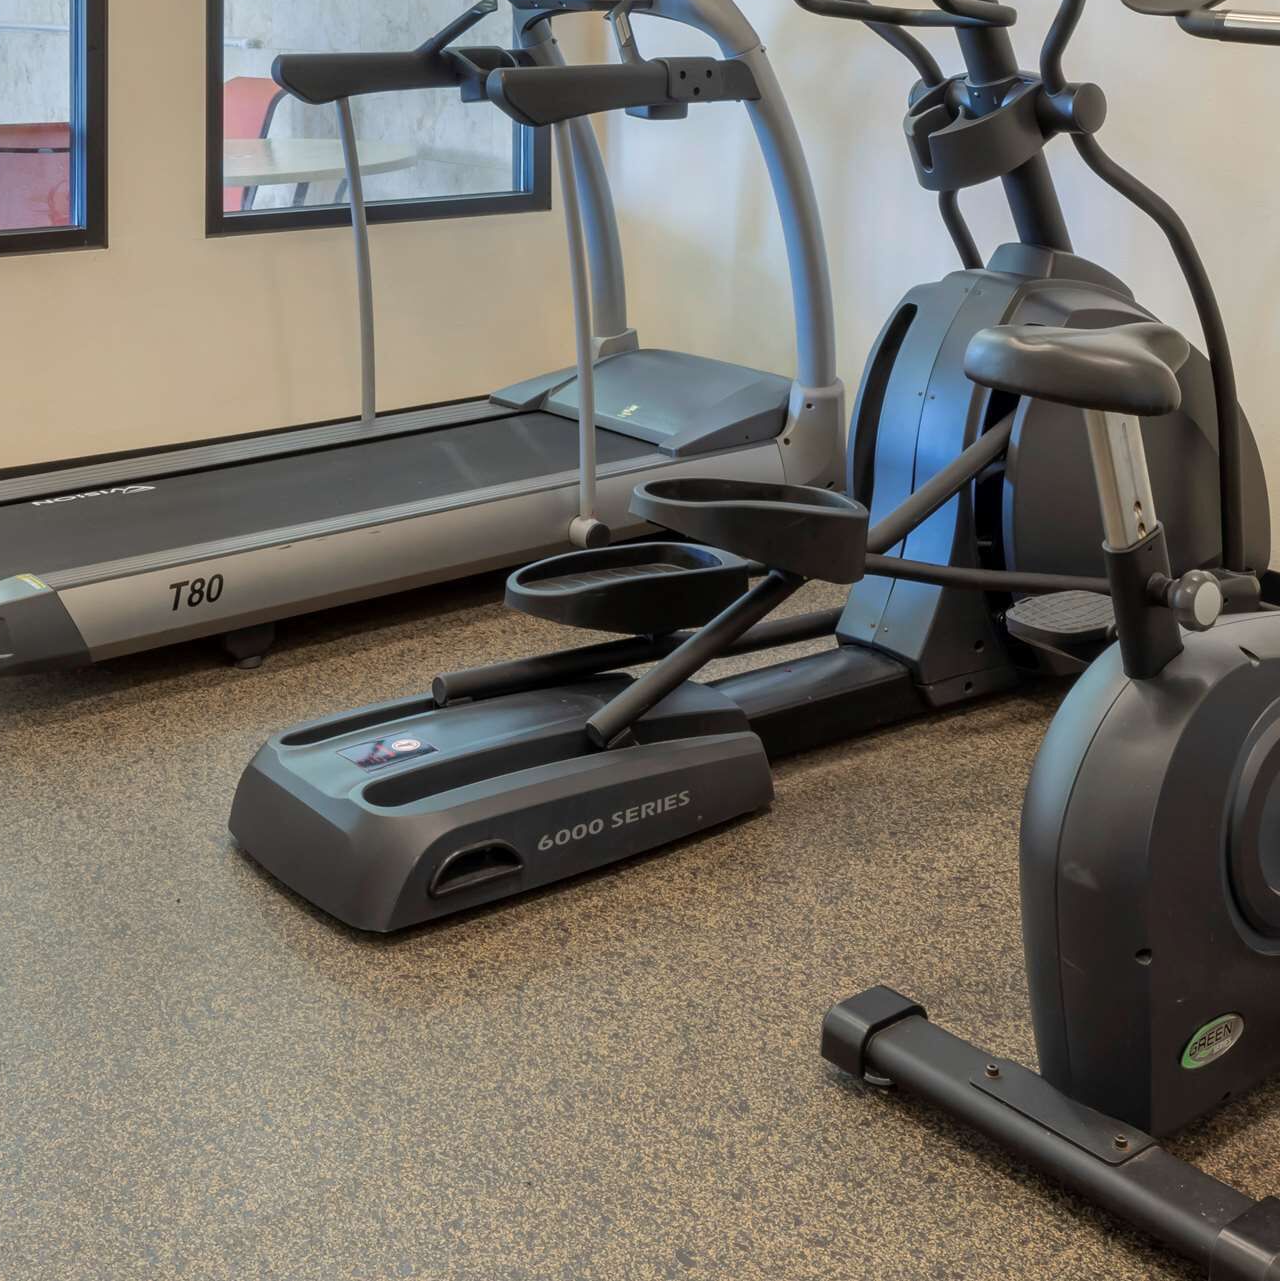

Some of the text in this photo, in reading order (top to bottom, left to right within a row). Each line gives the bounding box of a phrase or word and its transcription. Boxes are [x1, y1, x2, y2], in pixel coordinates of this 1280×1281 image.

[169, 574, 224, 611] T80
[537, 790, 690, 851] 6000 SERIES
[1189, 1022, 1233, 1057] GREEN
